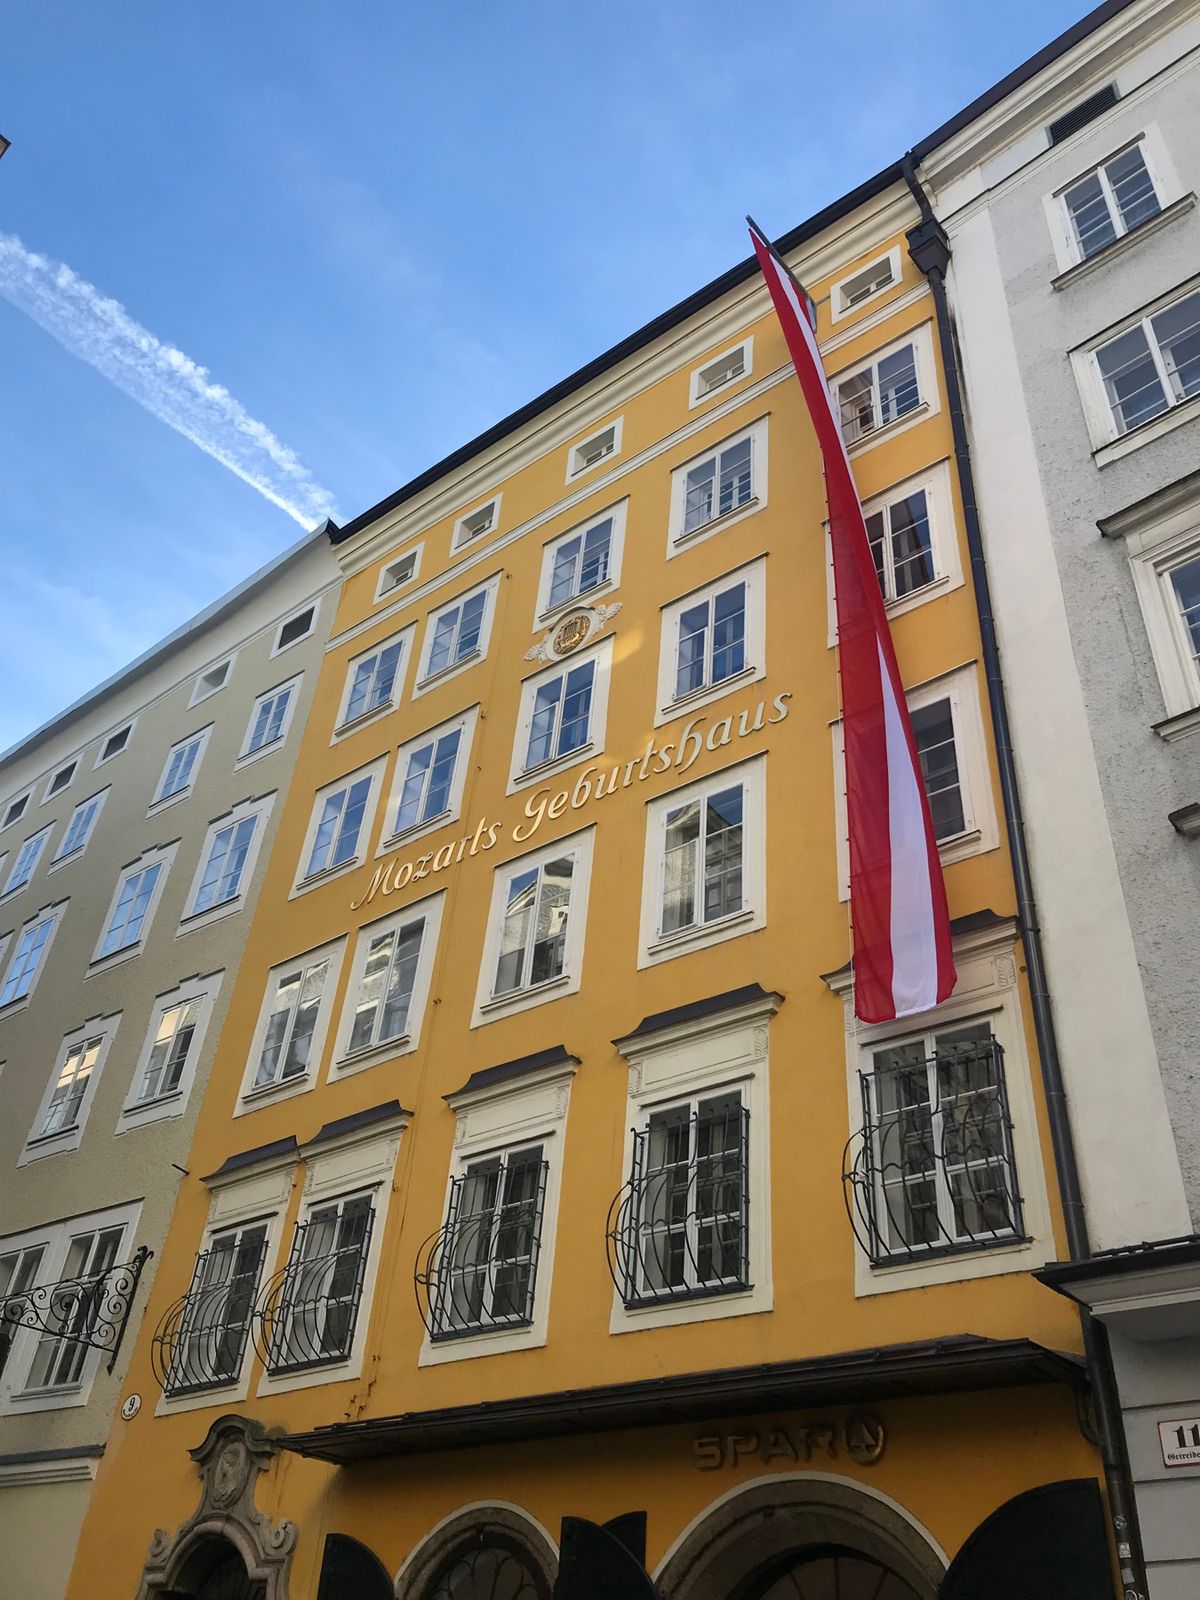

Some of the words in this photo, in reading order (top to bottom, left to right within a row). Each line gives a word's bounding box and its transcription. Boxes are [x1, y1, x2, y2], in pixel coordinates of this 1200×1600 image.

[351, 817, 502, 910] Mozarts
[512, 692, 793, 842] Geburtshaus
[128, 1396, 135, 1411] 9
[694, 1424, 837, 1470] SPAR
[1172, 1424, 1200, 1449] 11
